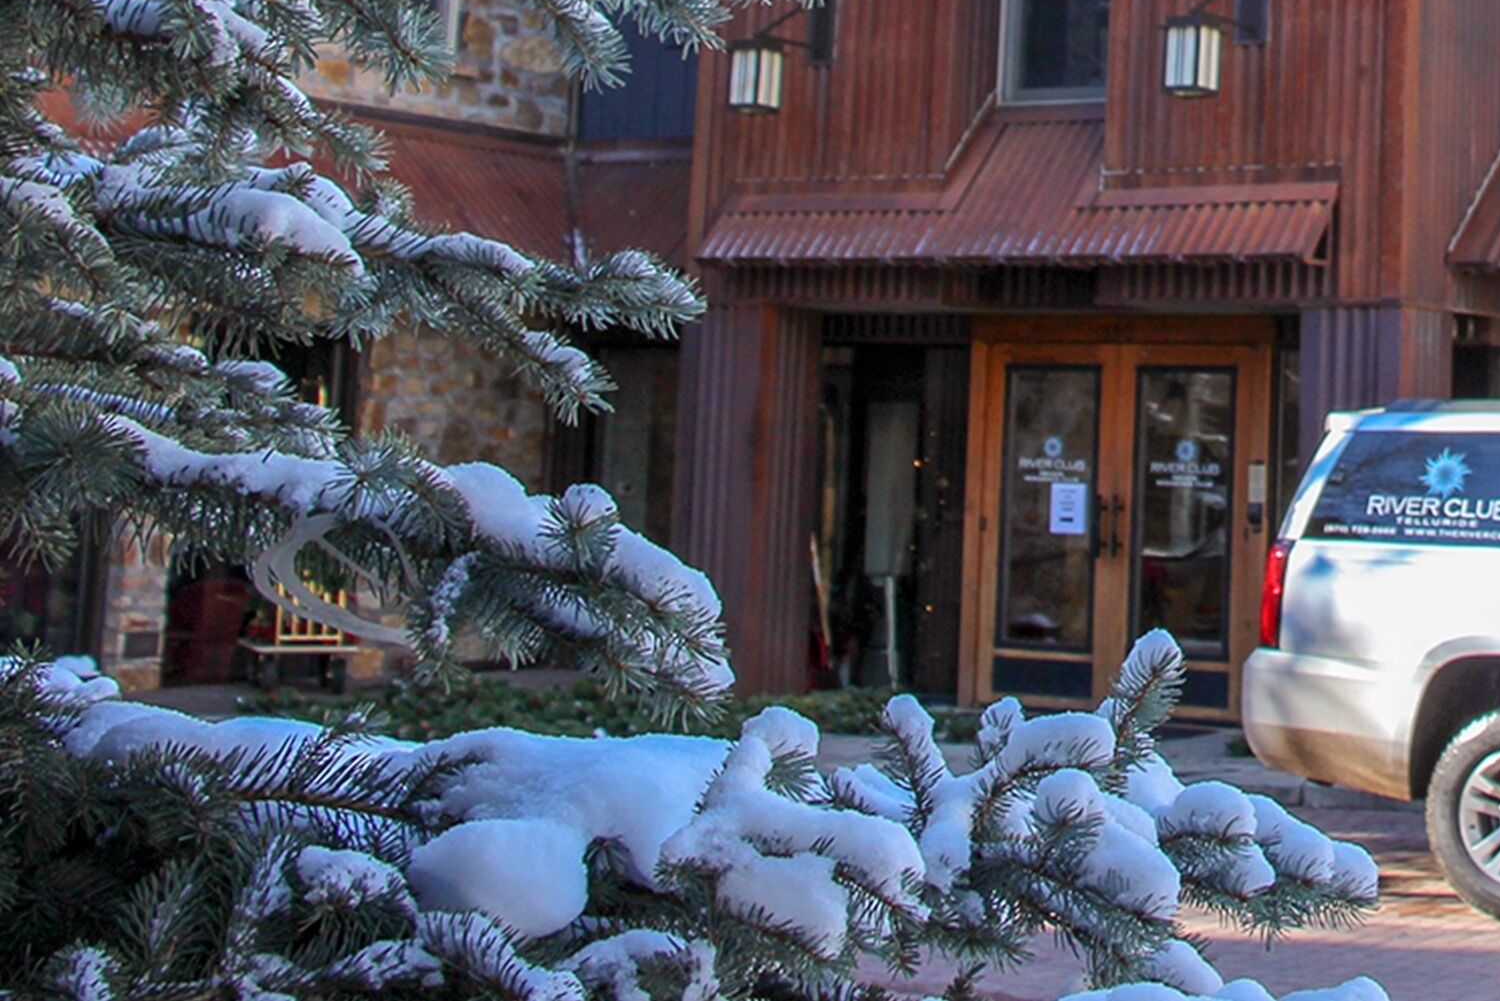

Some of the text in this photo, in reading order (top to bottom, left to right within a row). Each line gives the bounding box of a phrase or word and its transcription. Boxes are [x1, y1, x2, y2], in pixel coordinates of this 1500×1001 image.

[1019, 457, 1086, 472] RIVER CLUB
[1150, 462, 1220, 476] RIVER CLUB
[1366, 495, 1440, 516] RIVER
[1396, 517, 1479, 528] TELLURIDE
